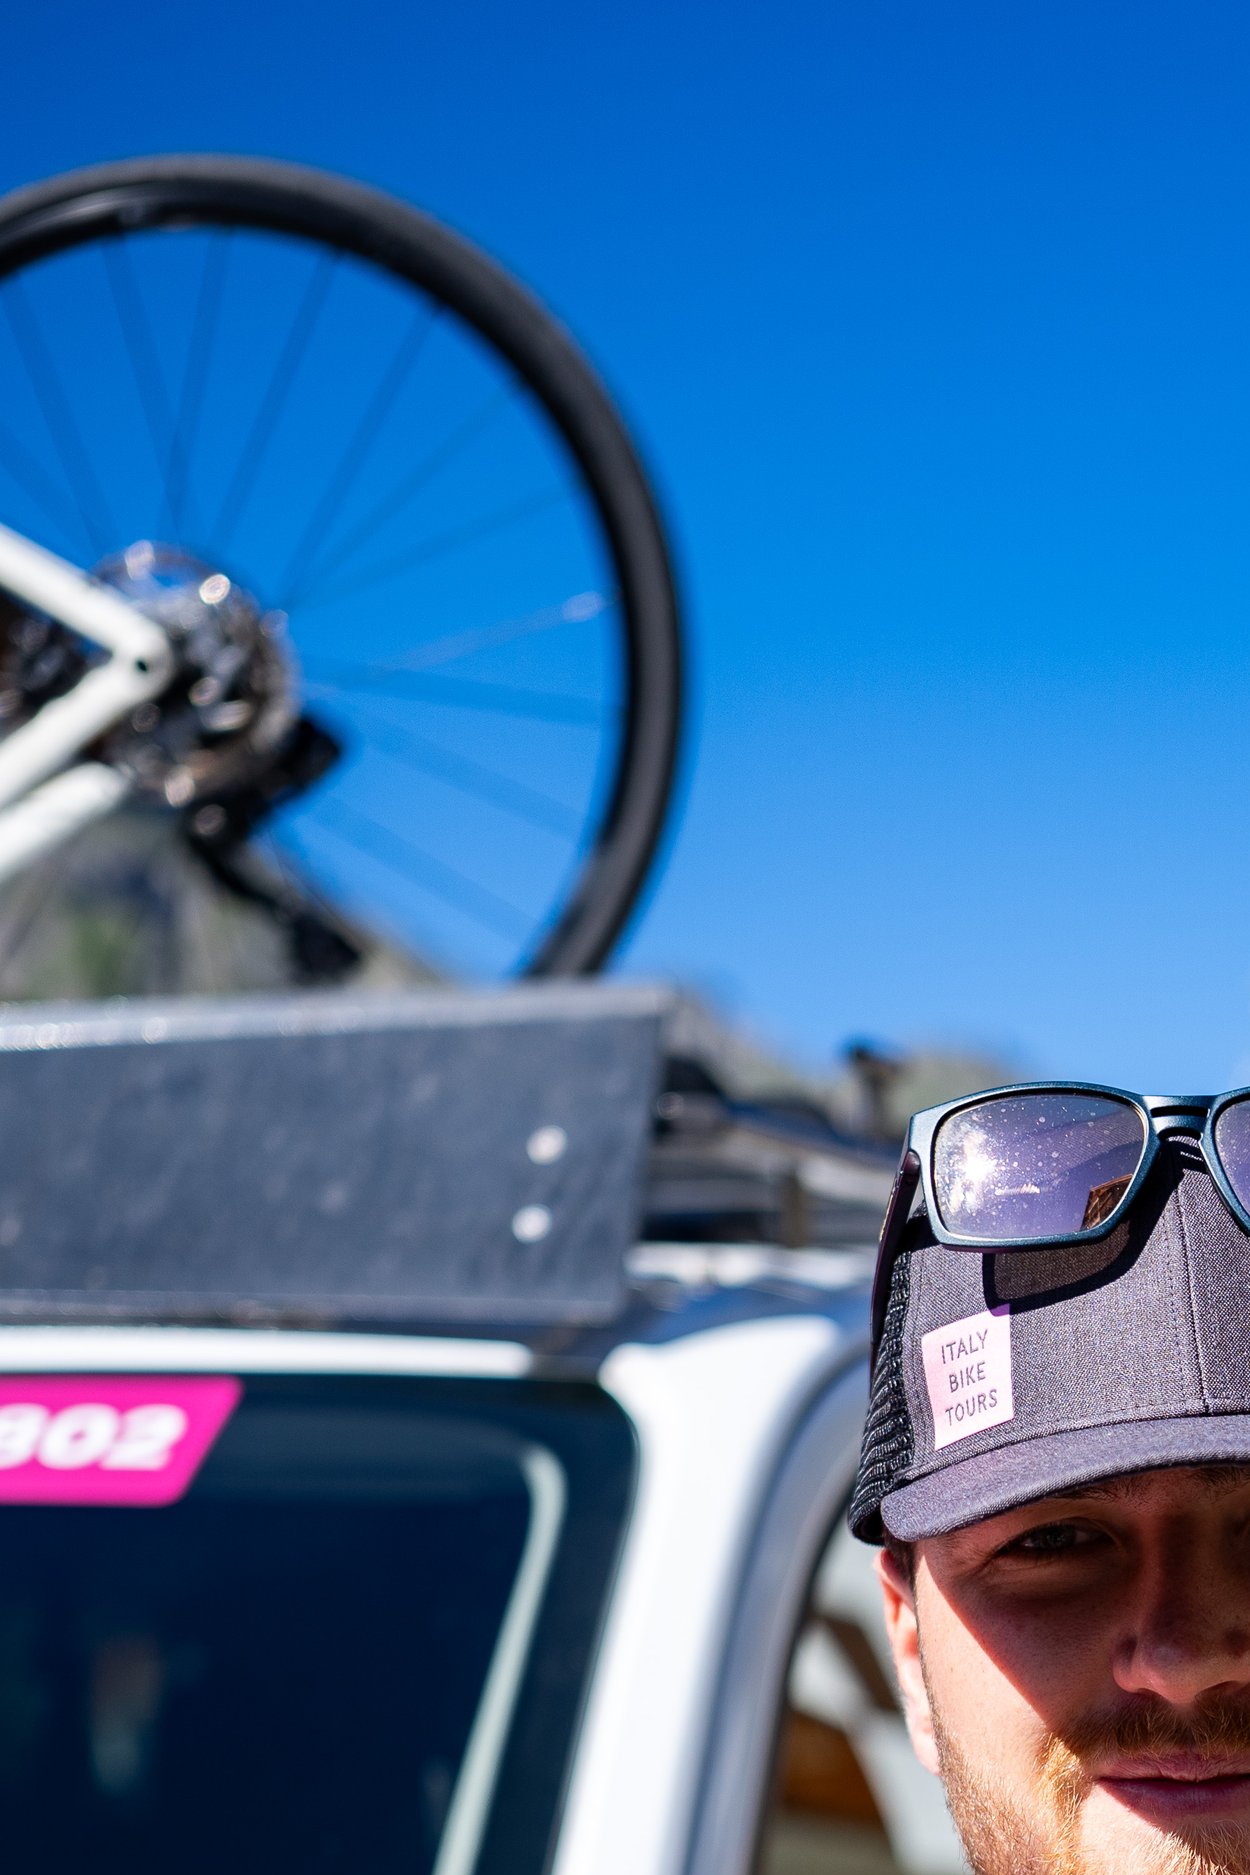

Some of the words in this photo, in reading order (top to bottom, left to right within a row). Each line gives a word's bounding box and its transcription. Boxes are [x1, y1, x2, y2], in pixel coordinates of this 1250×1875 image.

[941, 1328, 988, 1364] ITALY
[949, 1361, 986, 1393] BIKE
[945, 1388, 998, 1426] TOURS
